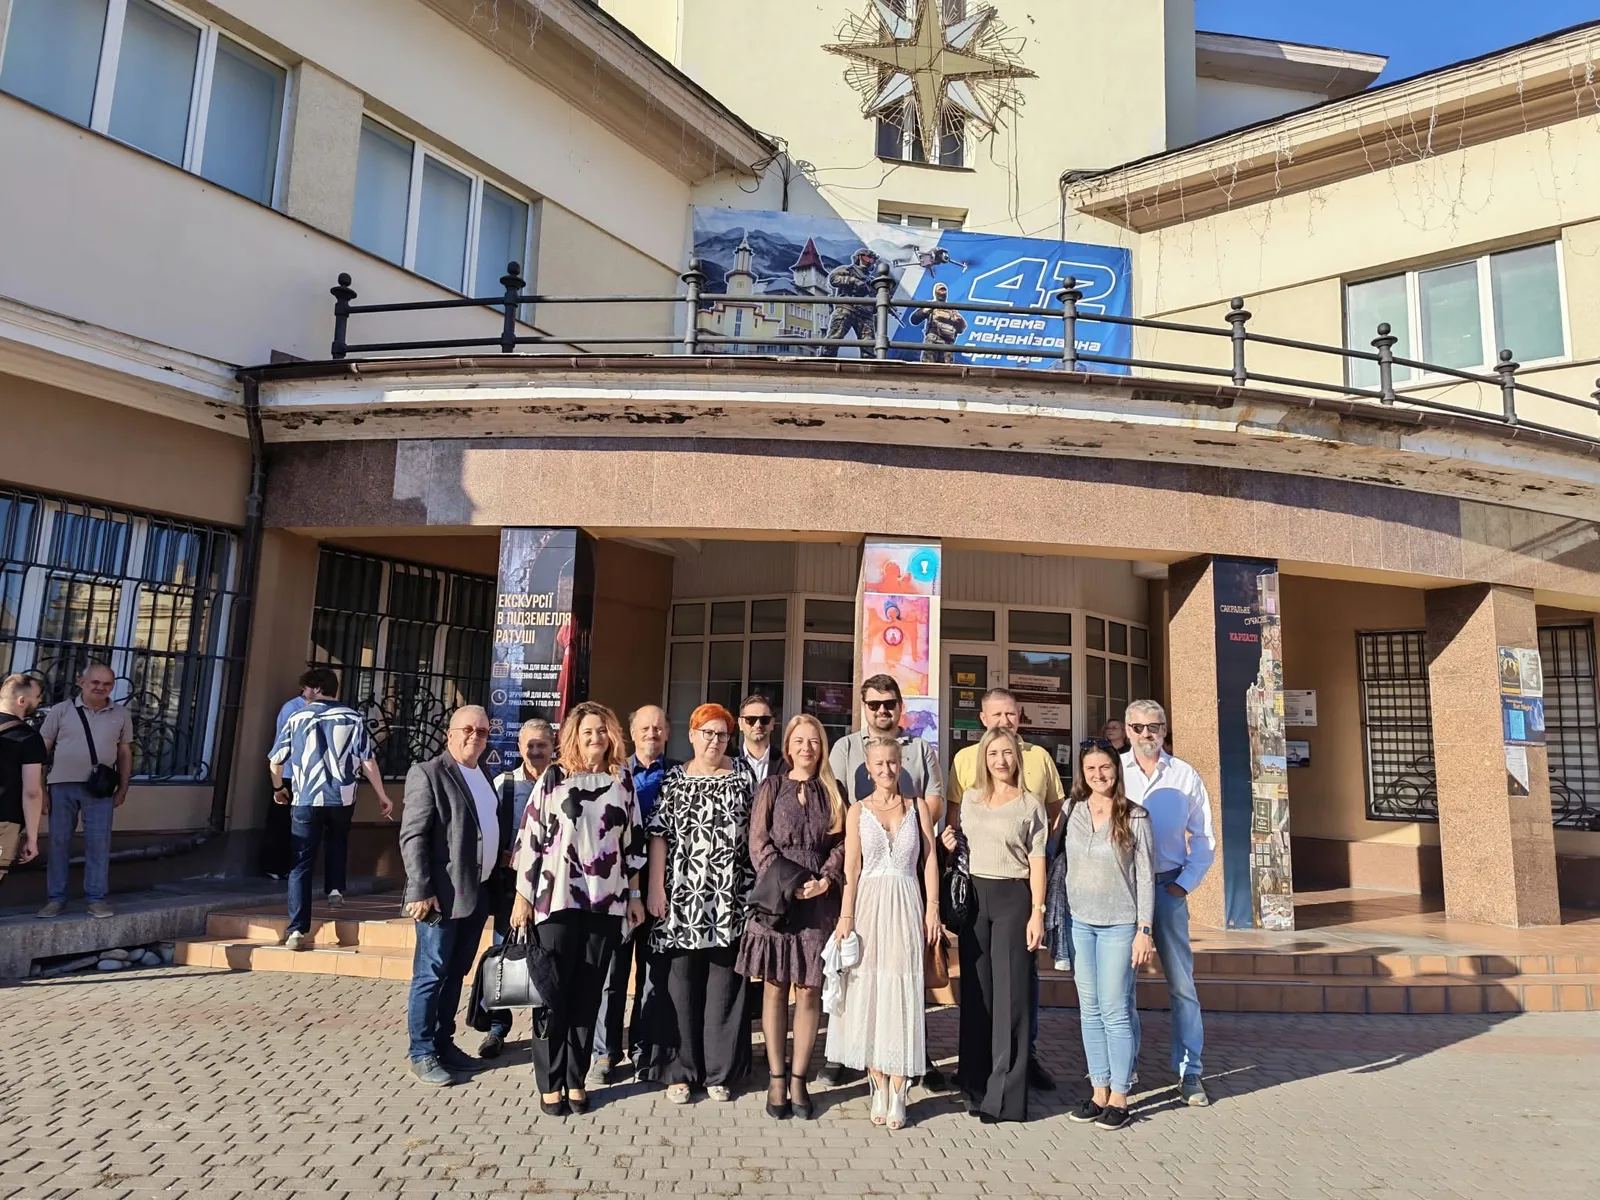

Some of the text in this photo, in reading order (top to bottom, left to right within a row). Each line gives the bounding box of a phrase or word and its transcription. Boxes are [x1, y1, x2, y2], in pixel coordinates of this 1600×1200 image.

[968, 257, 1116, 322] 42
[974, 315, 1046, 331] окрема
[968, 331, 1101, 352] механізовна
[498, 592, 554, 608] ЕКСКУРСІЇ
[497, 611, 572, 626] В ПІДЗЕМЕЛЛЯ
[495, 629, 536, 644] РАТУШІ
